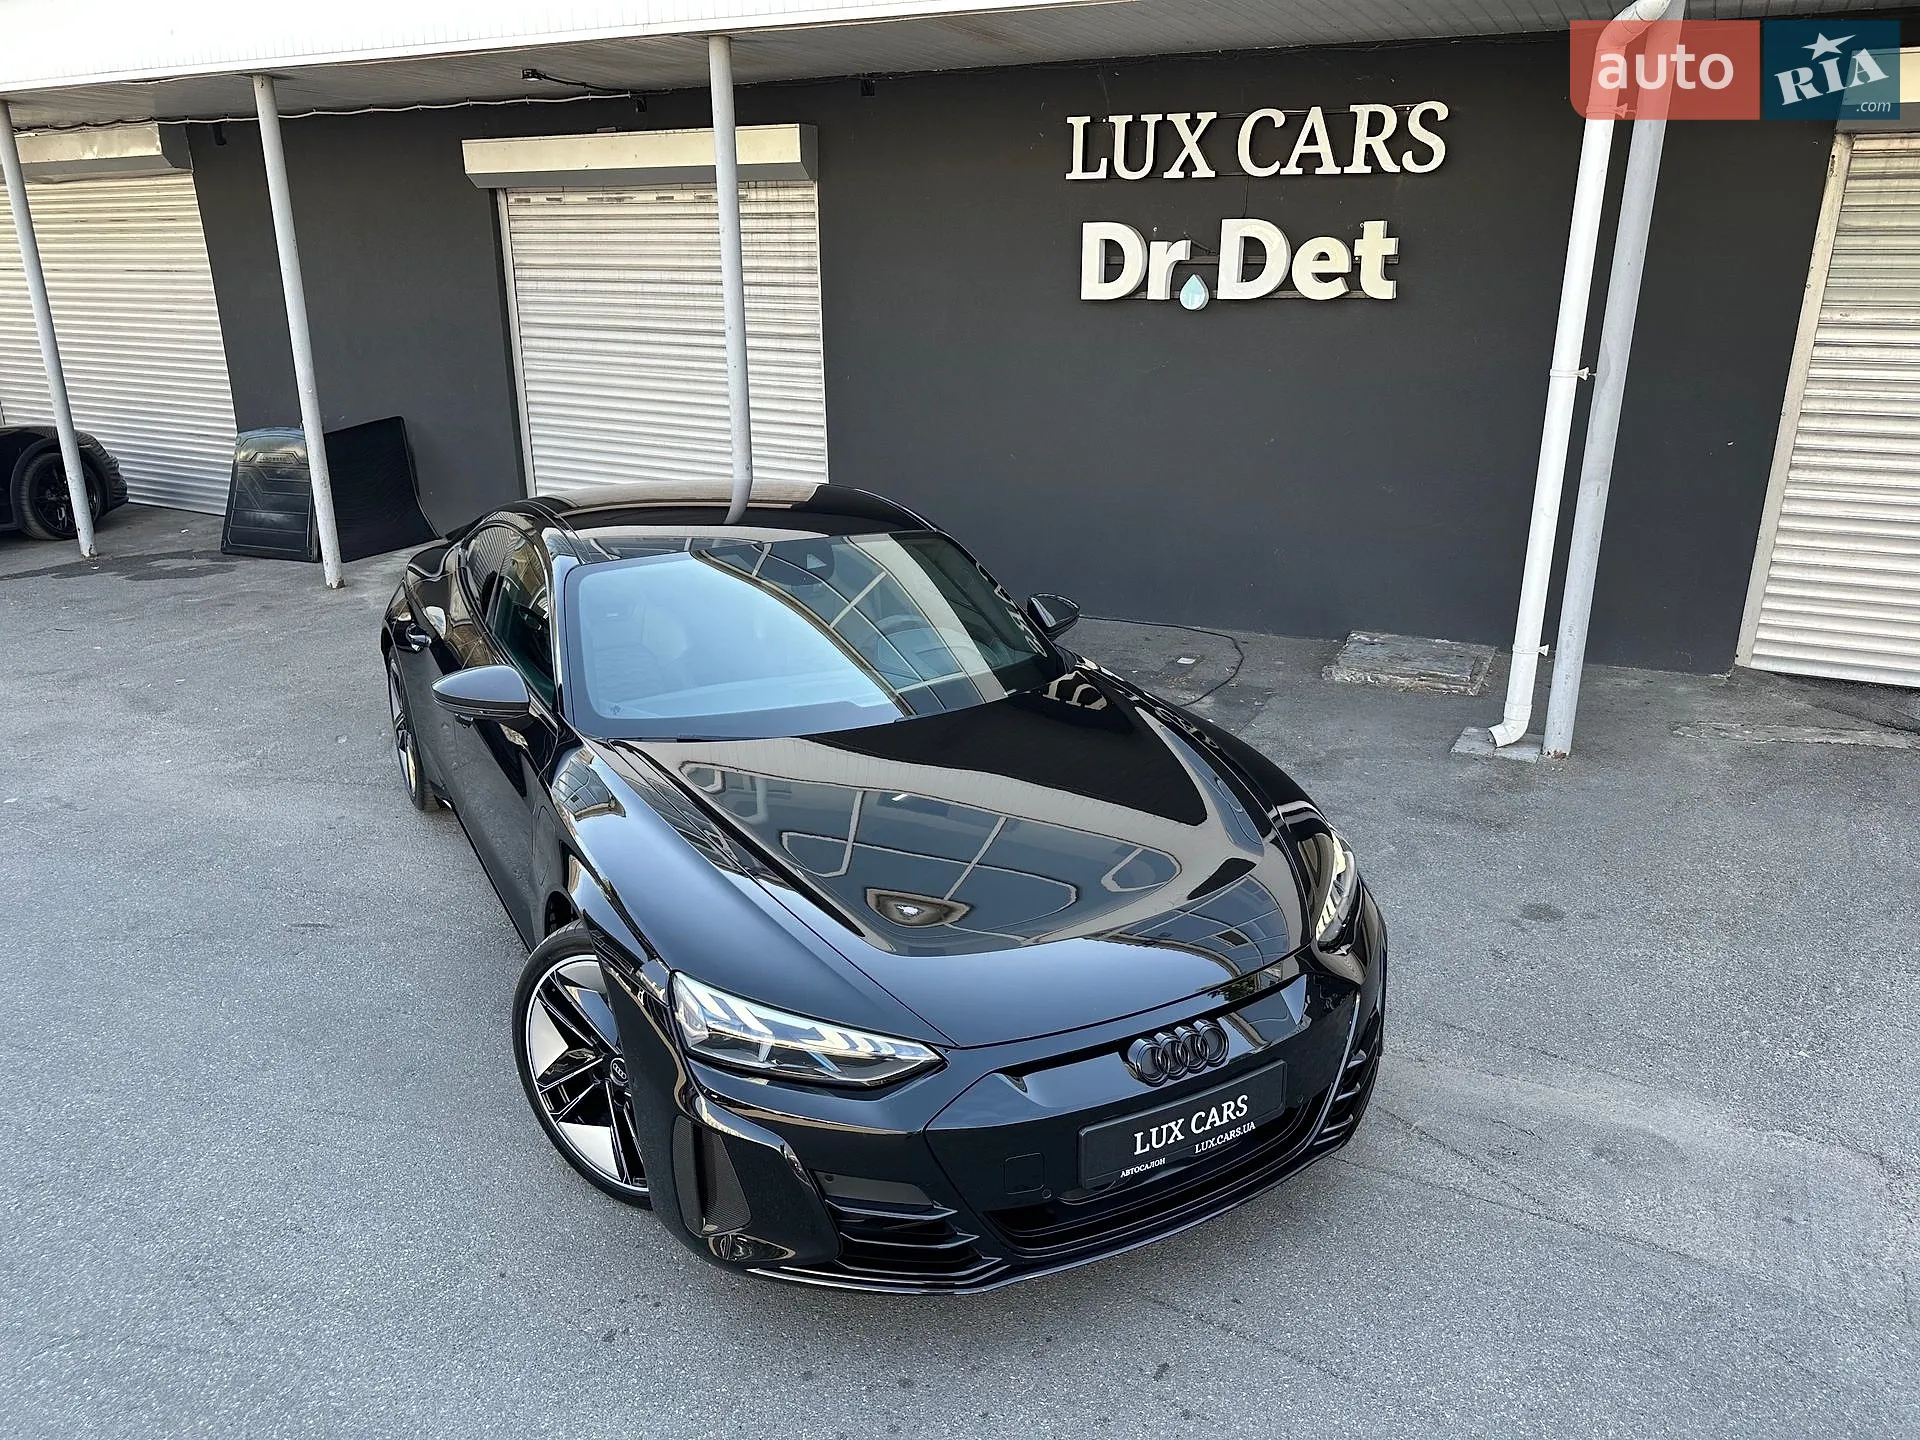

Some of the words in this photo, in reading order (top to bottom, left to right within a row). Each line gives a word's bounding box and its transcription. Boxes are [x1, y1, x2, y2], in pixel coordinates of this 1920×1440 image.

[1066, 111, 1218, 180] LUX
[1237, 101, 1449, 177] CARS
[1133, 1118, 1185, 1156] LUX
[1190, 1094, 1248, 1134] CARS
[1194, 1121, 1256, 1154] LUX.CARS.UA
[1120, 1157, 1166, 1178] АВТОСАЛОН
